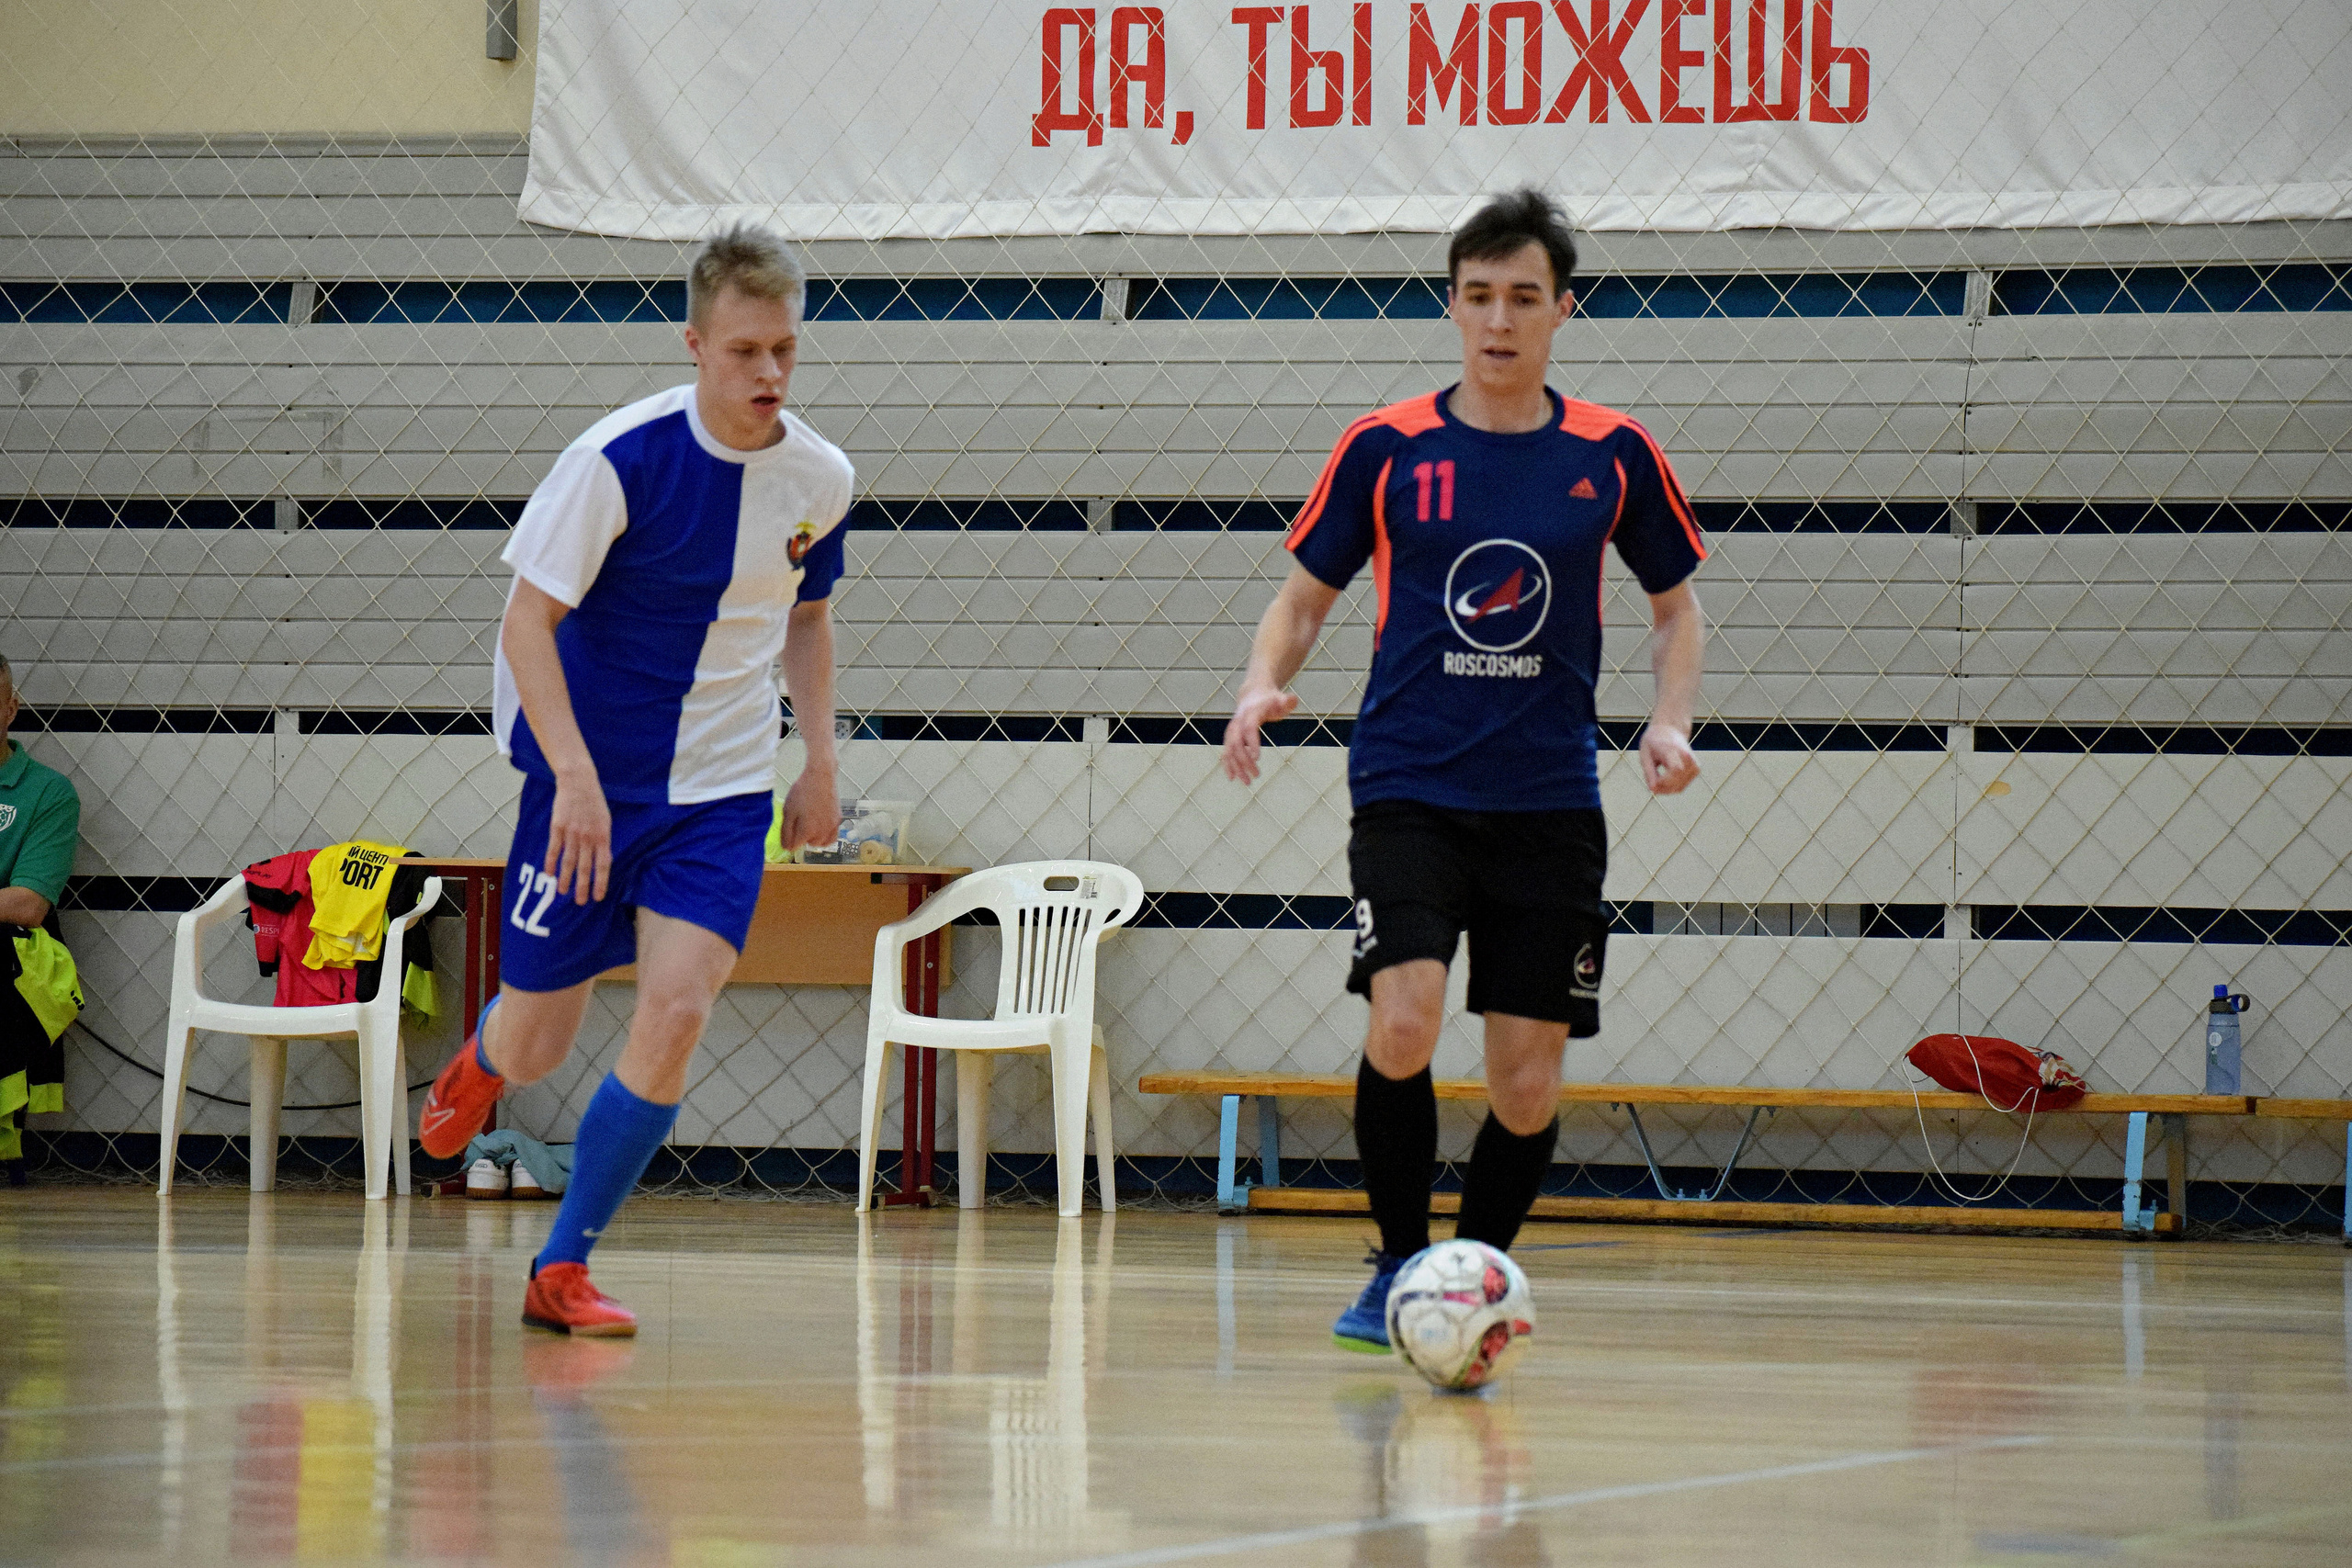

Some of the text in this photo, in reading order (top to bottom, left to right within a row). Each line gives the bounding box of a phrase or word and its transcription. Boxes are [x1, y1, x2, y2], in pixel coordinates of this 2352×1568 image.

[1032, 0, 1870, 147] ДА, ТЫ МОЖЕШЬ
[1412, 459, 1456, 523] 11
[1443, 650, 1544, 679] ROSCOSMOS
[510, 862, 558, 938] 22
[1355, 897, 1374, 940] 9
[260, 926, 280, 935] RESP
